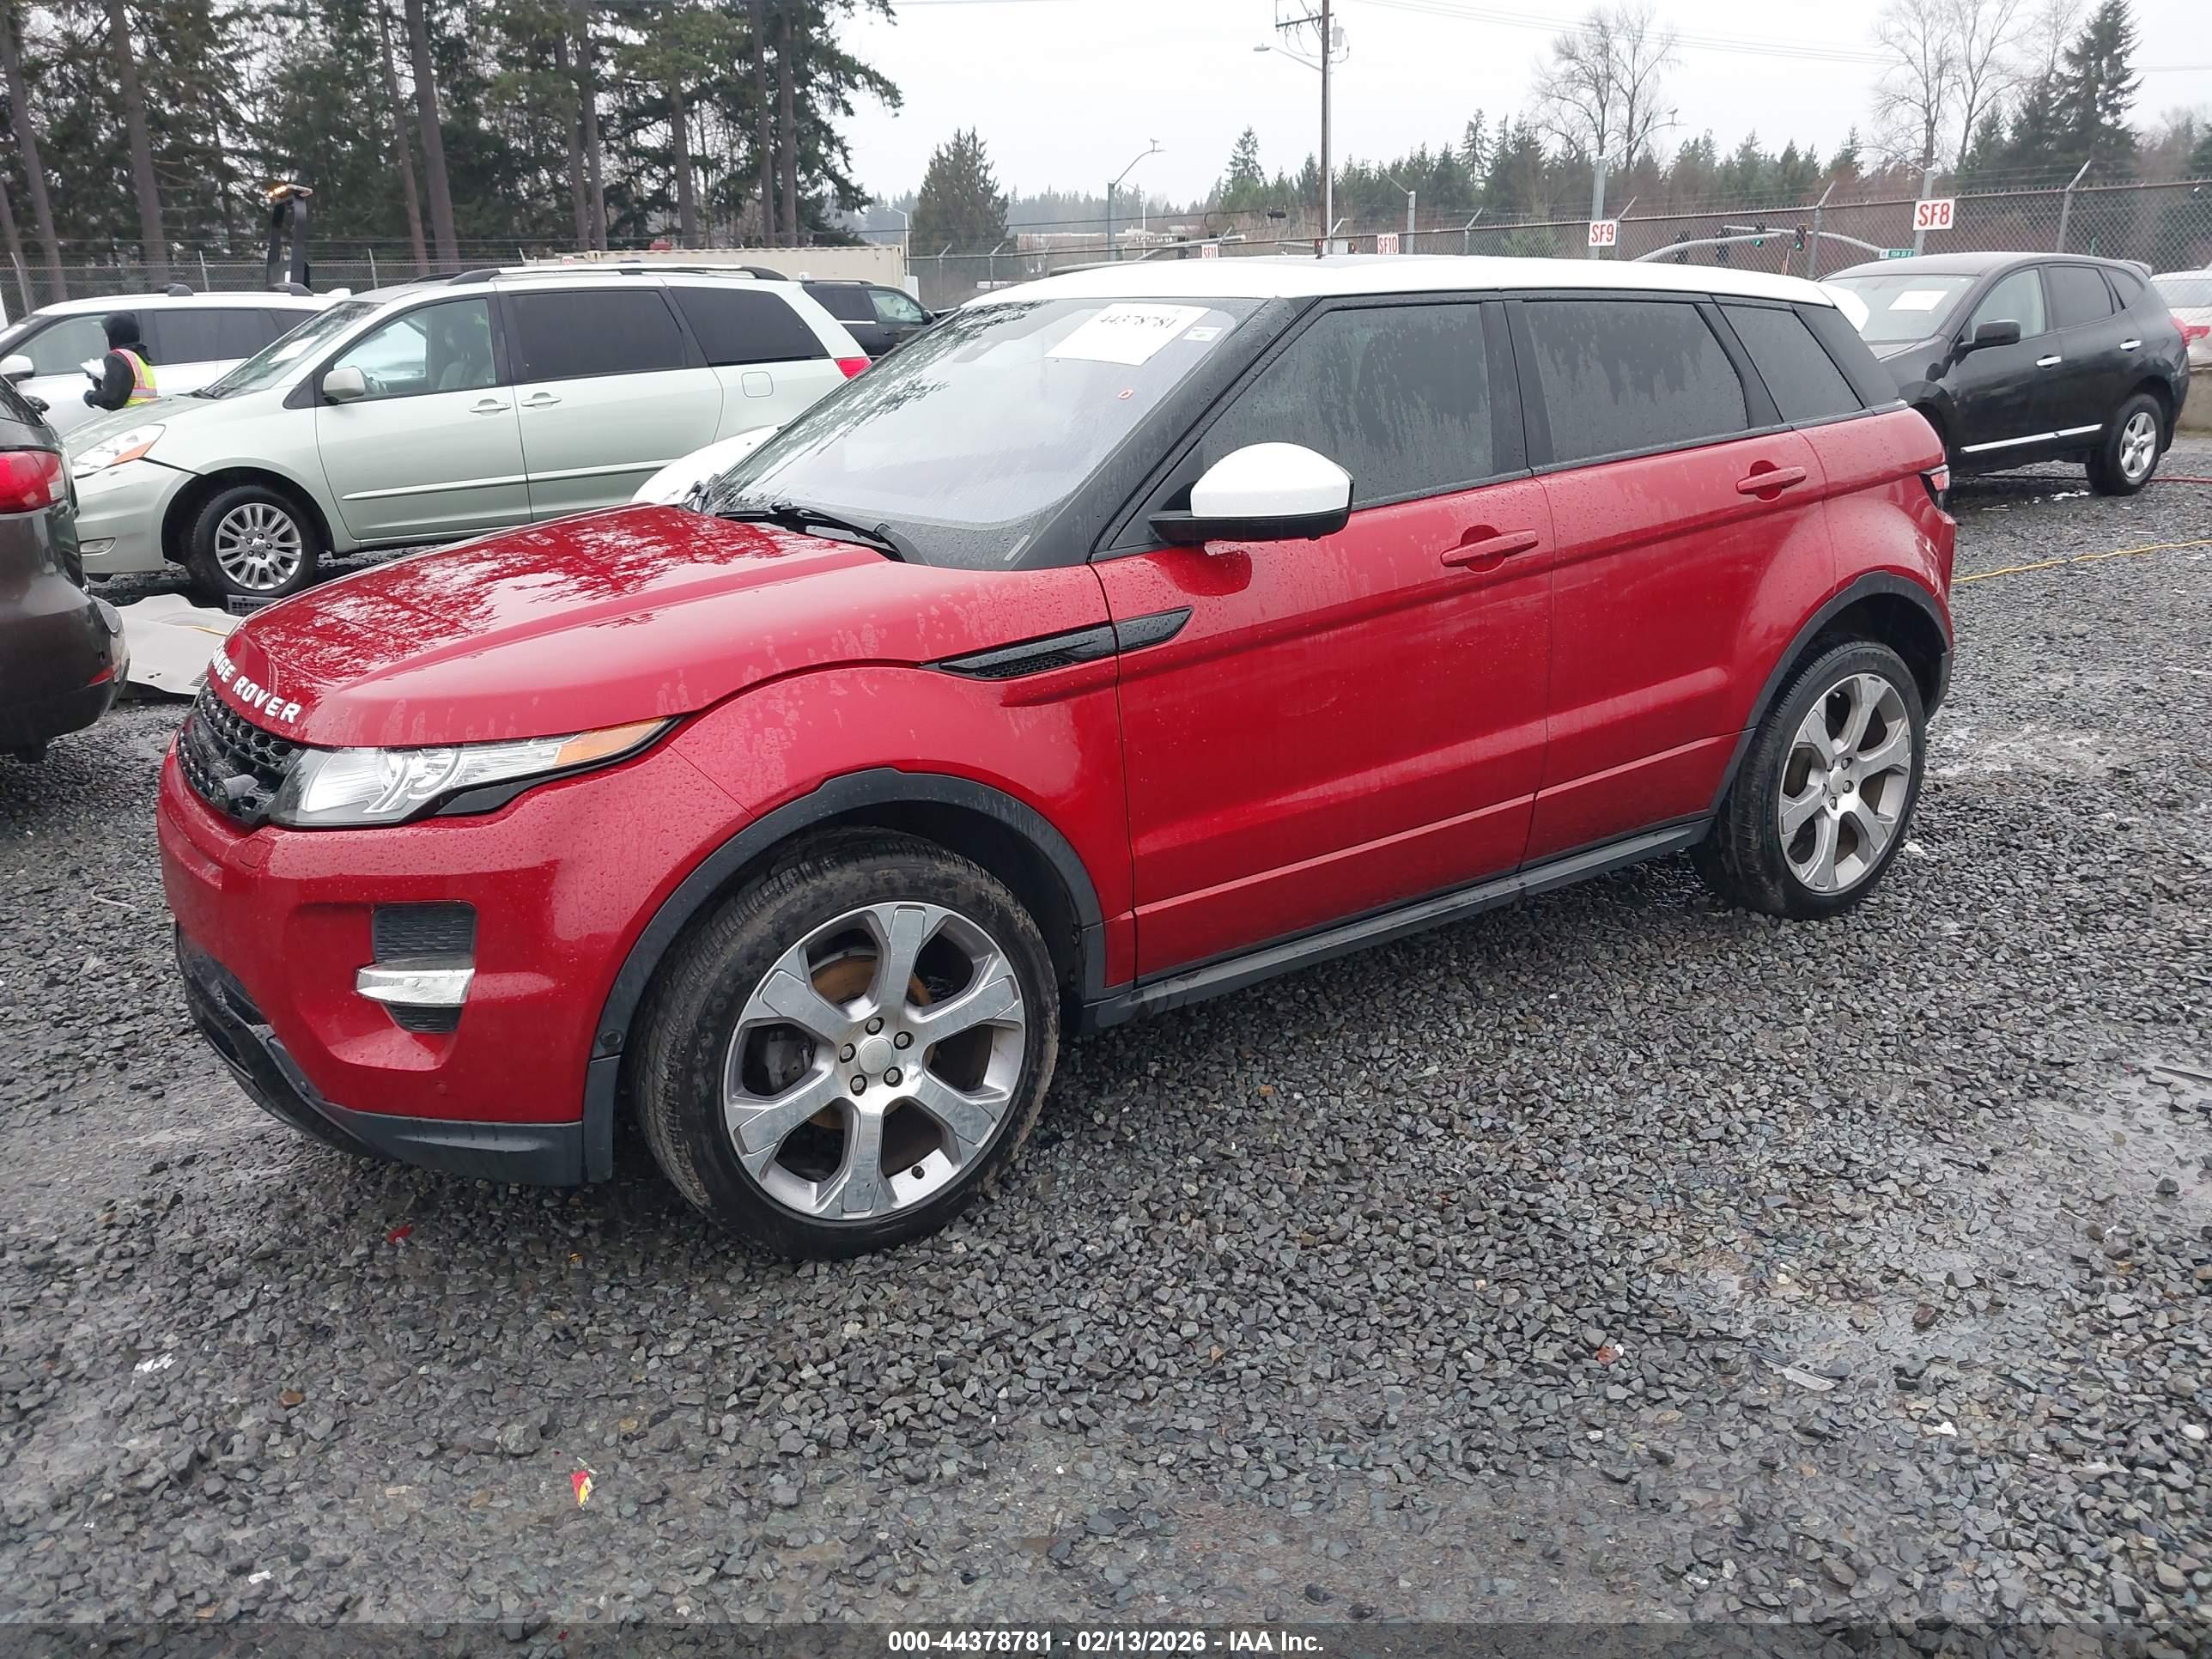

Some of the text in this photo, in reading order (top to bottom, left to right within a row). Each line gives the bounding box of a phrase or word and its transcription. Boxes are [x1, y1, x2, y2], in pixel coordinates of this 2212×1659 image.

[1918, 203, 1950, 226] SF8
[1592, 223, 1614, 243] SF9
[1378, 236, 1398, 254] SF10
[232, 675, 302, 724] ROVER
